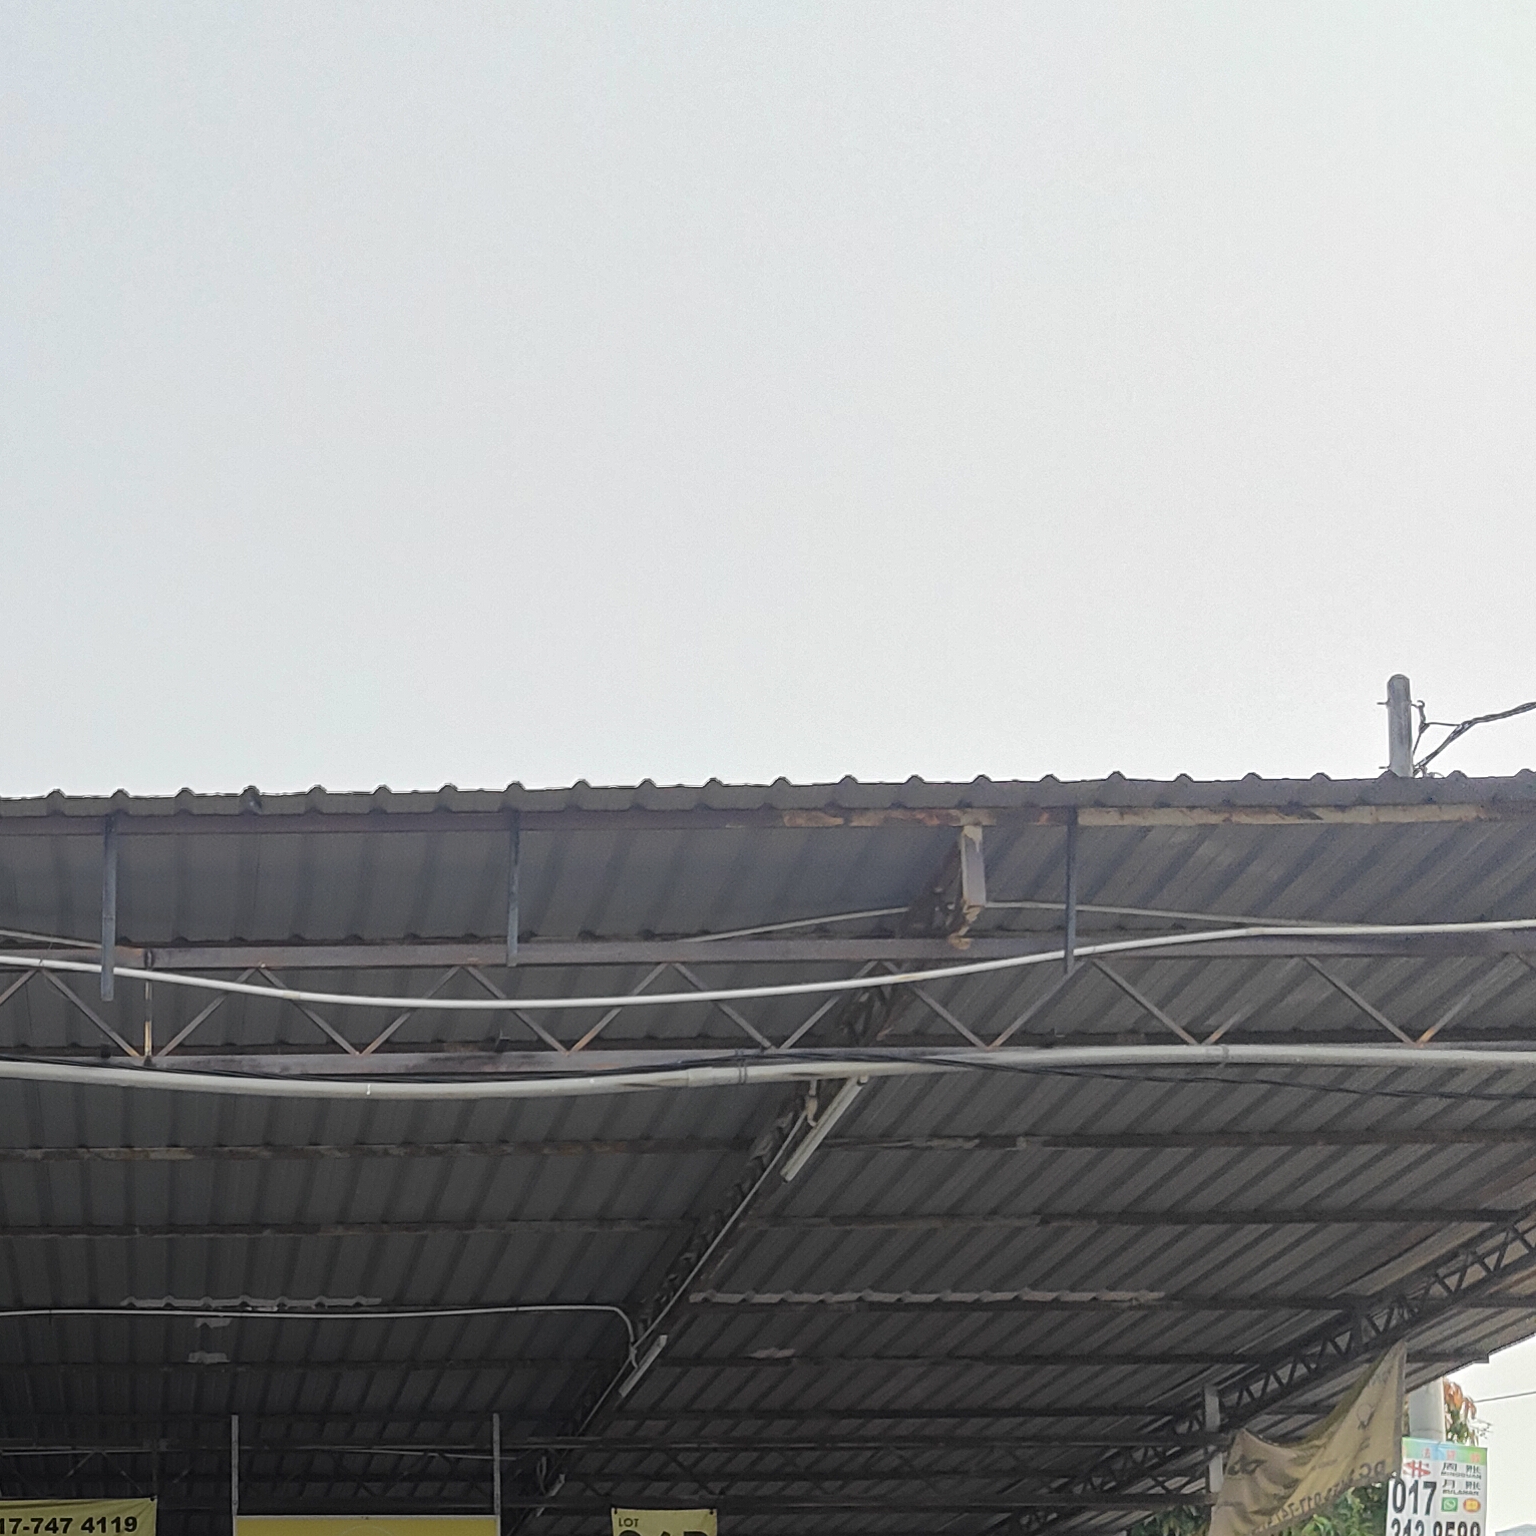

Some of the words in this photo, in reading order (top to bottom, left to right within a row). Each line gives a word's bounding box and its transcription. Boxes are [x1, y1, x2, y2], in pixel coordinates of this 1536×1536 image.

[1392, 1479, 1437, 1515] 017
[80, 1517, 138, 1533] 4119
[618, 1518, 639, 1528] LOT
